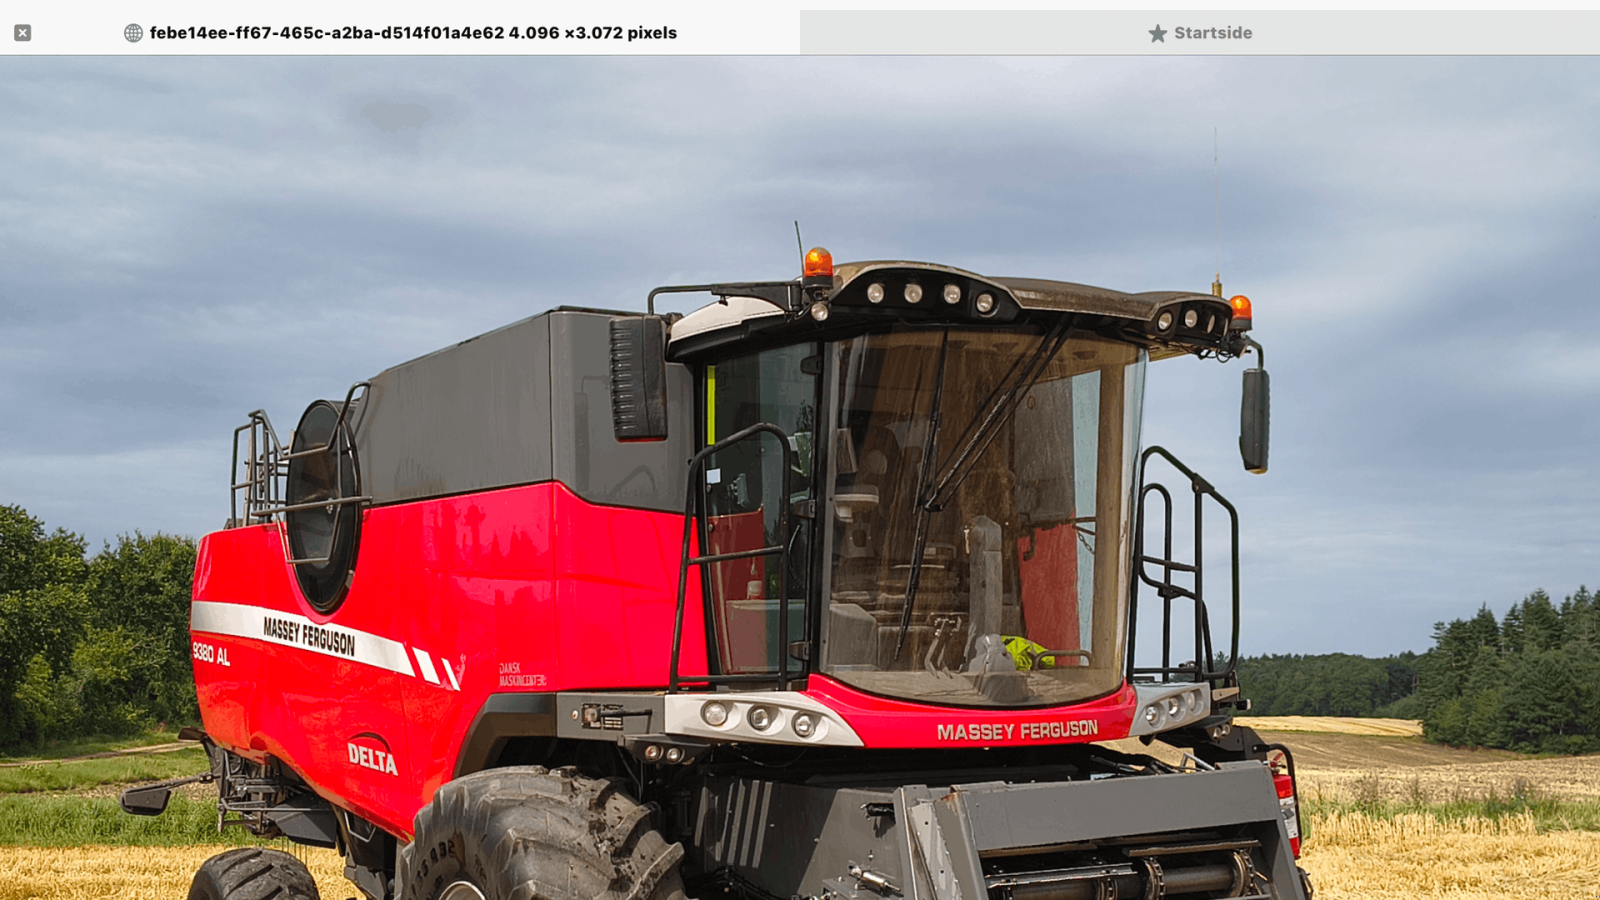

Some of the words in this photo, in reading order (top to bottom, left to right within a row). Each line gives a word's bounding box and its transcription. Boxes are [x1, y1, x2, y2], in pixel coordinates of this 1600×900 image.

[264, 616, 300, 643] MASSEY
[303, 624, 355, 657] FERGUSON
[193, 642, 214, 663] 9380
[217, 648, 231, 666] AL
[499, 662, 521, 675] DANSK
[937, 724, 1015, 741] MASSEY
[1020, 719, 1099, 740] FERGUSON
[347, 742, 399, 777] DELTA
